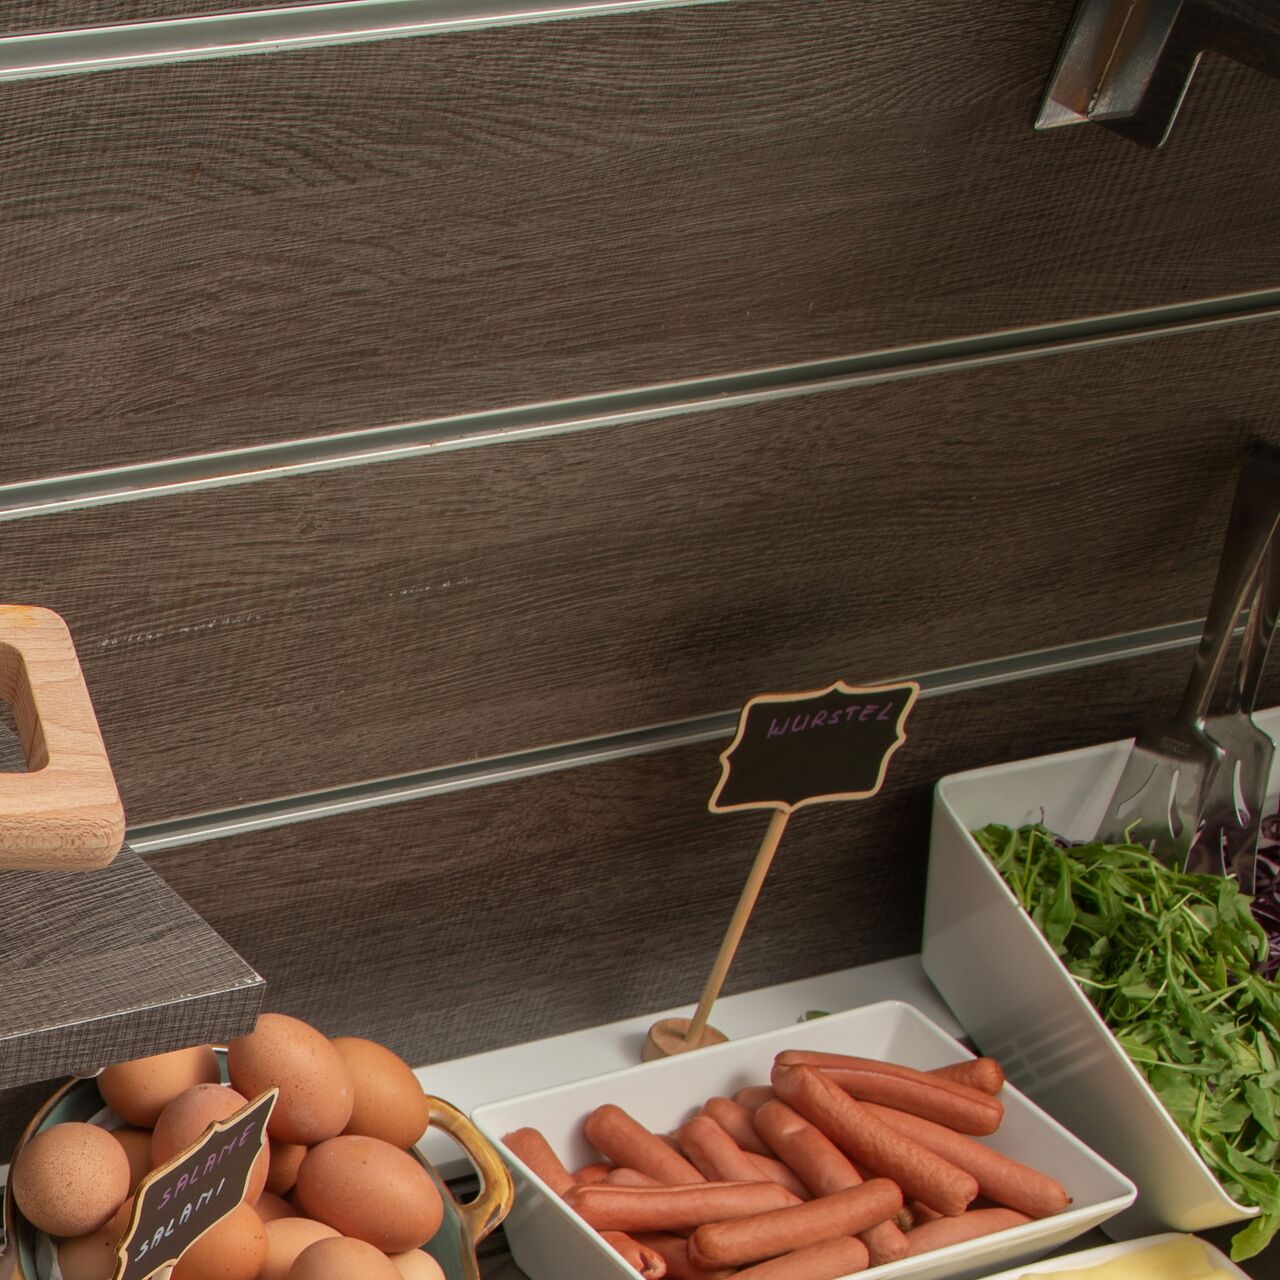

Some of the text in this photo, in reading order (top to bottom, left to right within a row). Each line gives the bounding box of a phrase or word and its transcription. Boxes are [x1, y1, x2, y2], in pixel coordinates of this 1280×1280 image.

[767, 702, 894, 739] WURSTEL
[157, 1121, 256, 1210] SALAME
[134, 1178, 225, 1263] SALAMI
